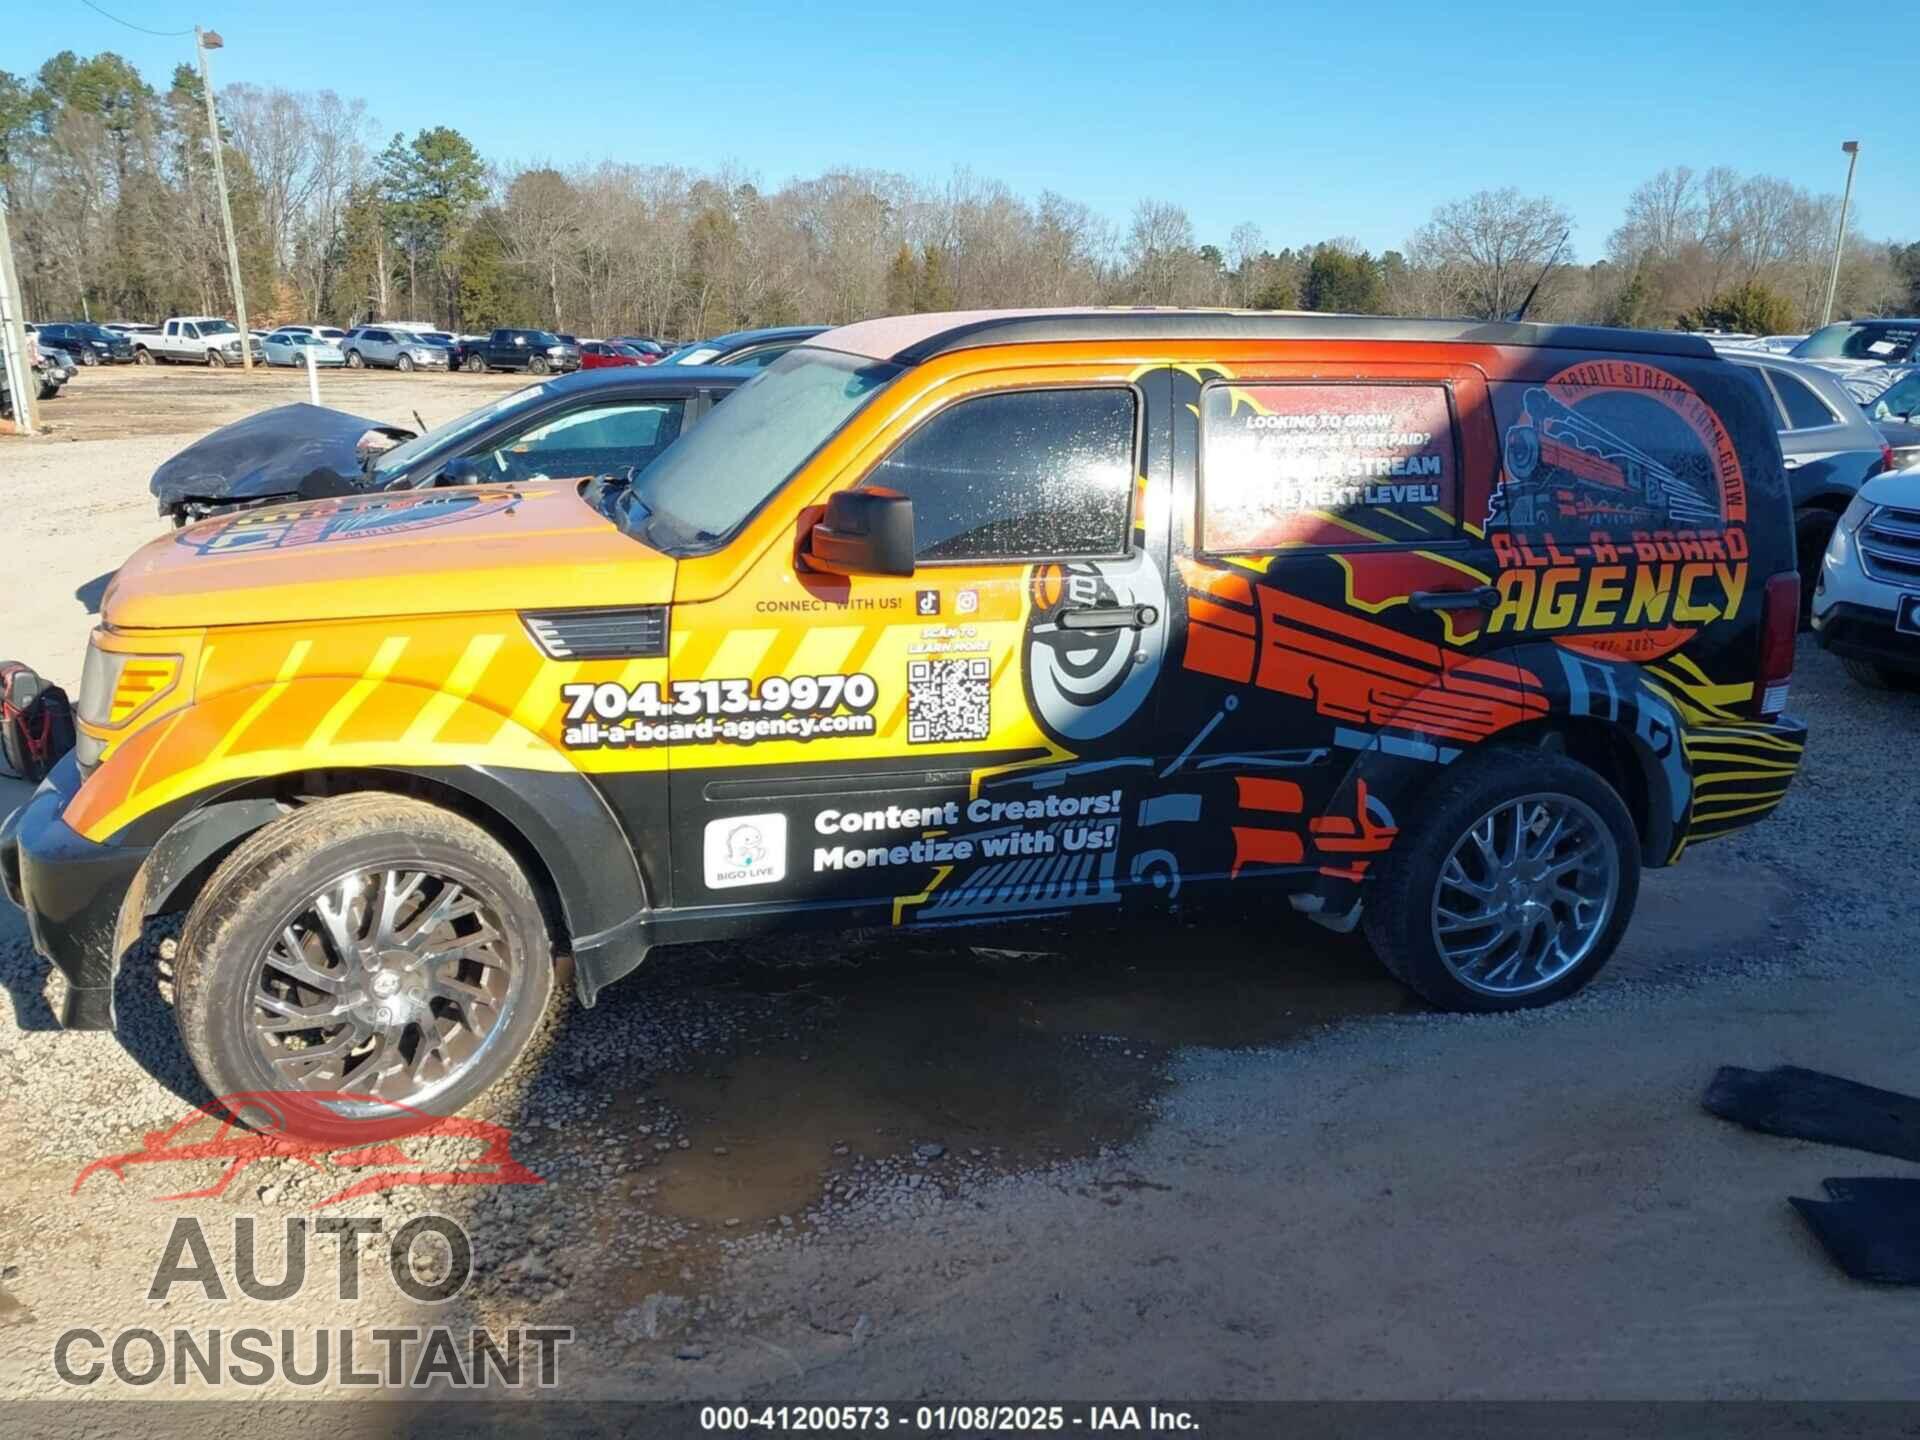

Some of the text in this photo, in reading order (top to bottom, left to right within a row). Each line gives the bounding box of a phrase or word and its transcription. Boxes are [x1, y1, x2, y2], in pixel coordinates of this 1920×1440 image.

[1246, 414, 1392, 429] LOOKING TO GROW
[1356, 433, 1385, 447] GET
[1389, 432, 1432, 446] PAID?
[1345, 456, 1441, 476] STREAM
[1364, 484, 1440, 504] LEVEL!
[1491, 527, 1749, 568] ALL-A-BOARD
[755, 597, 903, 613] CONNECT WITH US!
[1487, 562, 1748, 633] AGENCY
[562, 672, 877, 720] 704.313.9970
[564, 713, 873, 745] all-a-board-agency.com
[814, 789, 1122, 835] Content Creators!
[813, 825, 1116, 872] Monetize with Us!
[717, 866, 775, 881] BIGO LIVE
